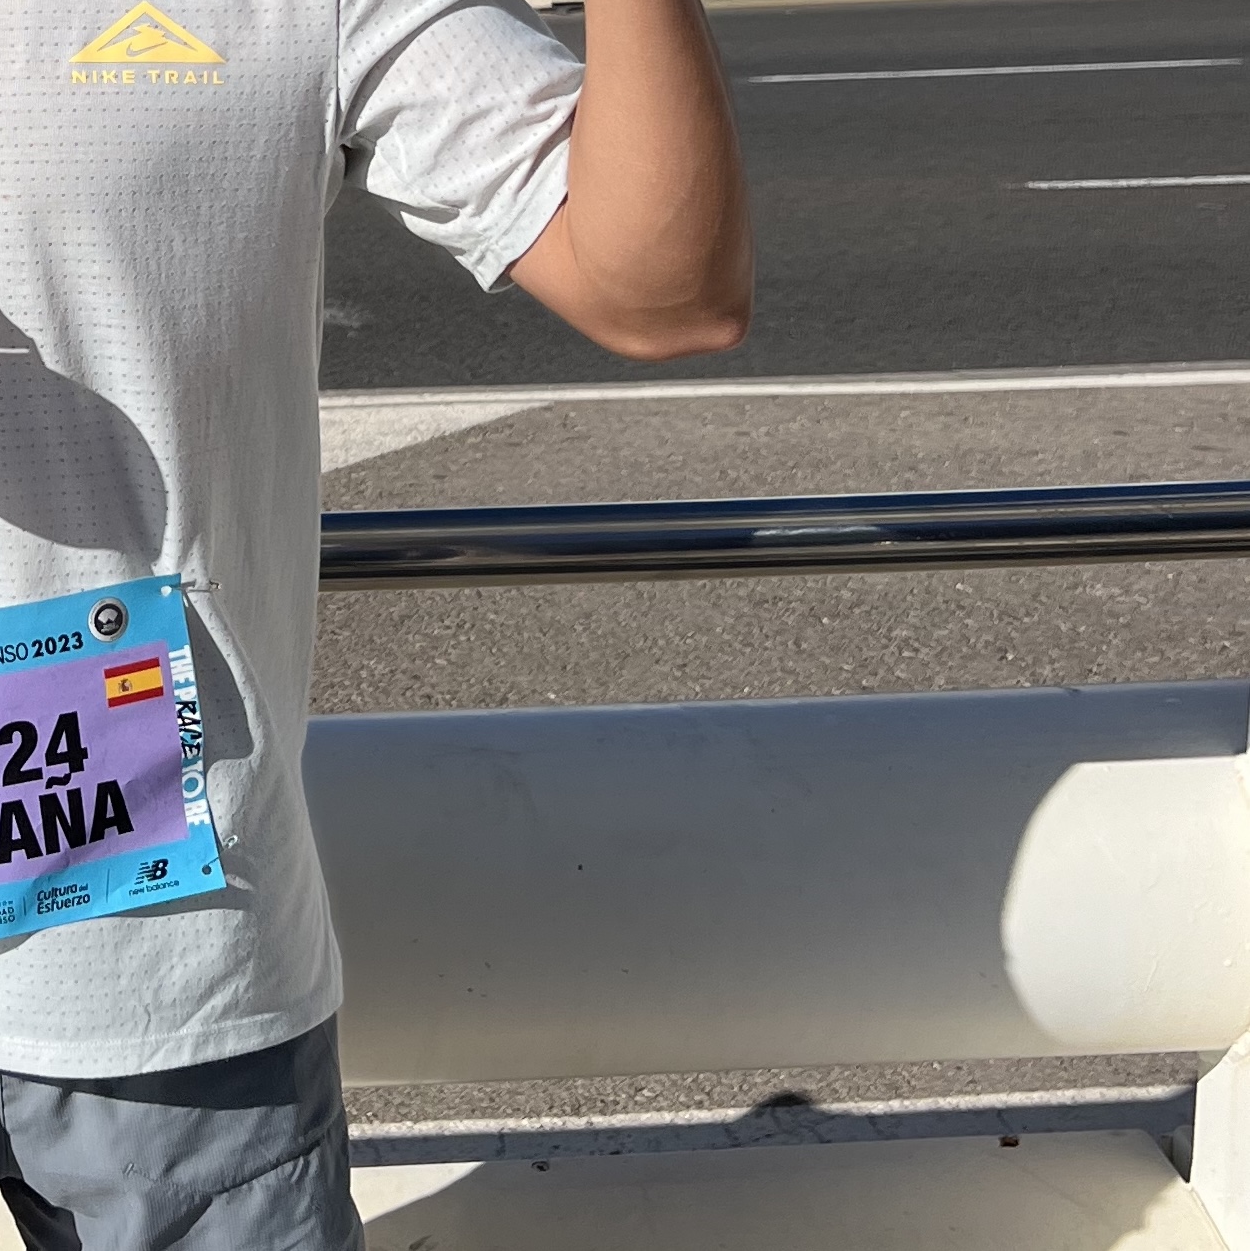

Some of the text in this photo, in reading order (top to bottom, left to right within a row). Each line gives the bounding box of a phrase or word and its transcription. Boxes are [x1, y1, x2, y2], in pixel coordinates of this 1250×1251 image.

[71, 70, 225, 85] NIKE TRAIL
[31, 631, 84, 658] 2023
[168, 644, 196, 687] THE
[36, 883, 78, 901] Cultura
[128, 880, 180, 896] new balance
[37, 893, 90, 914] Esfuerzo
